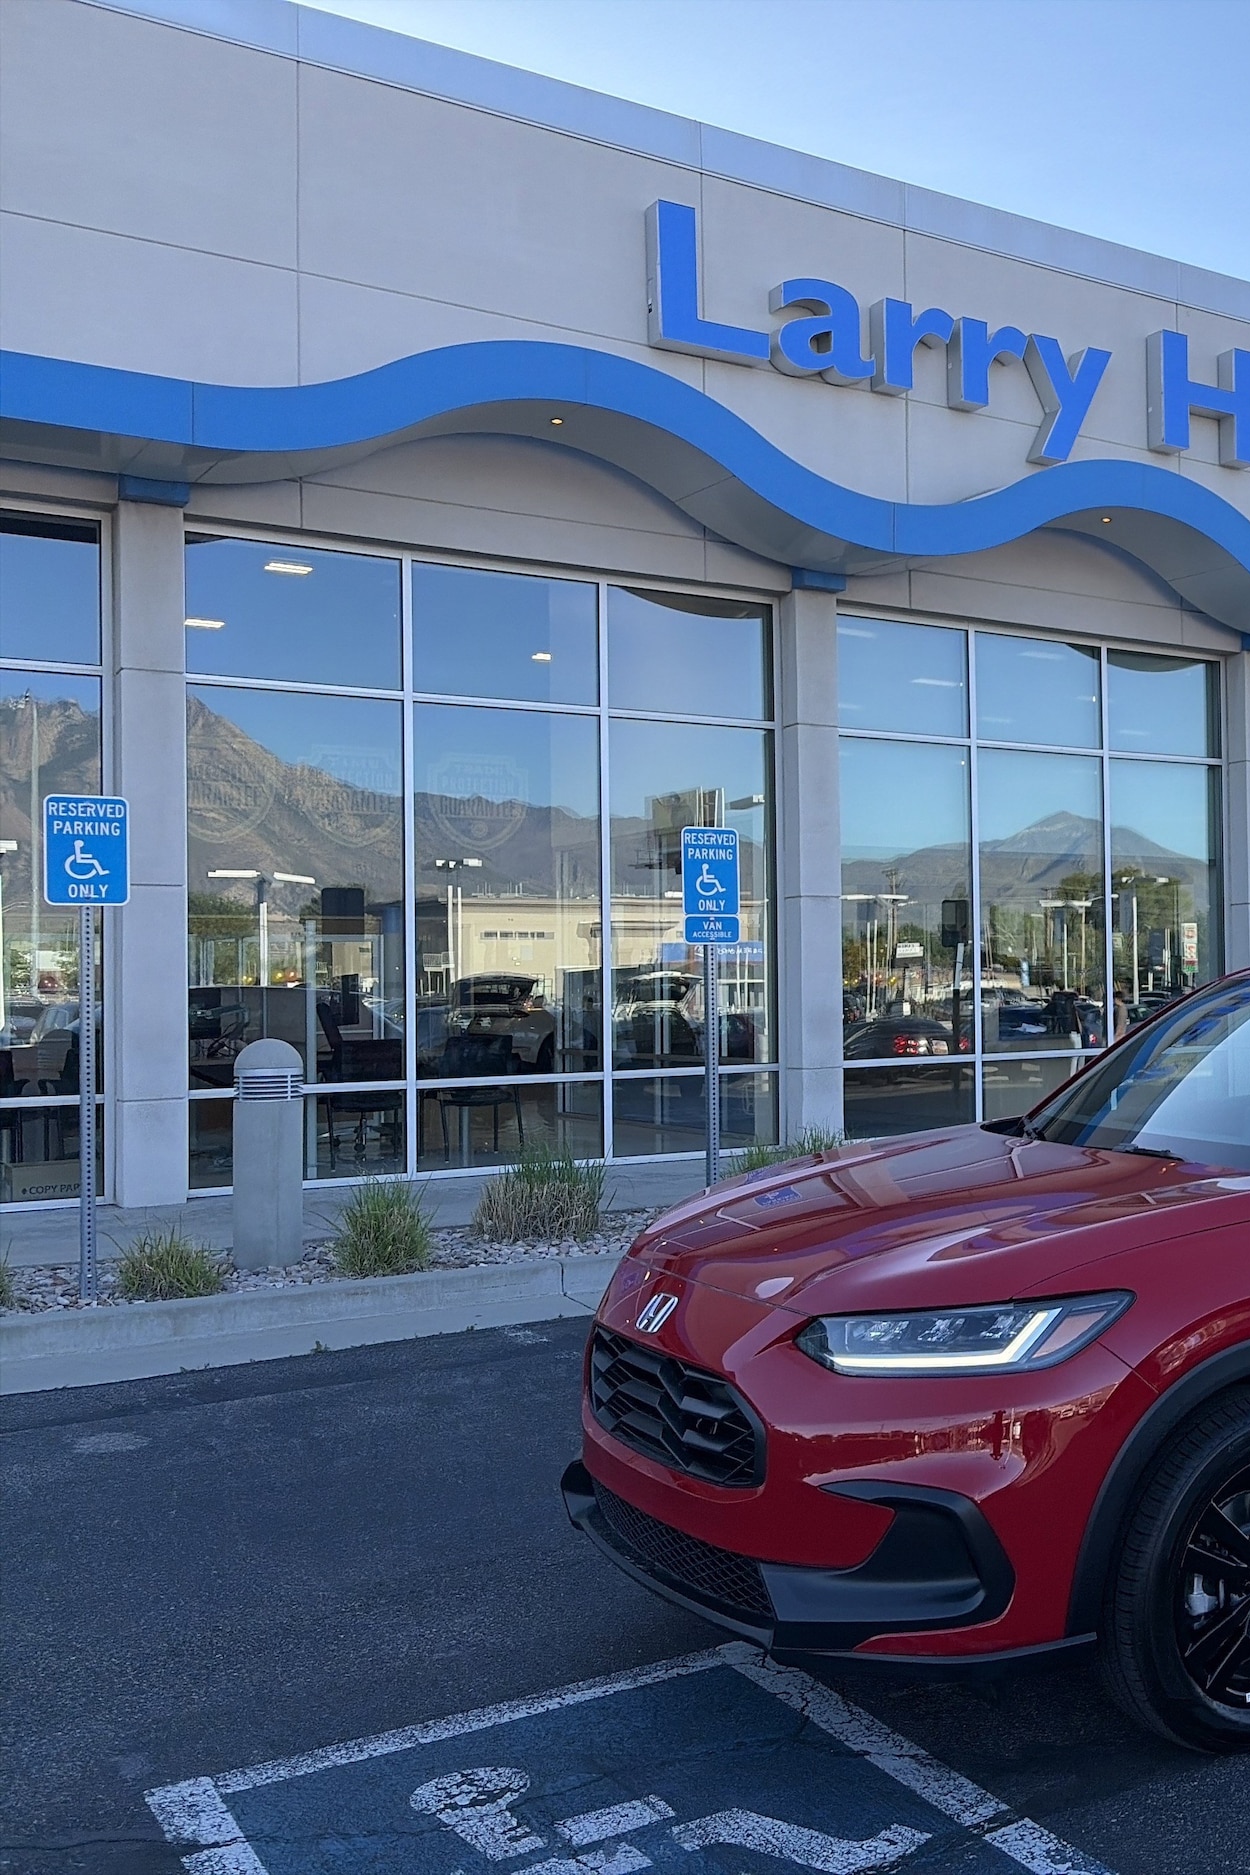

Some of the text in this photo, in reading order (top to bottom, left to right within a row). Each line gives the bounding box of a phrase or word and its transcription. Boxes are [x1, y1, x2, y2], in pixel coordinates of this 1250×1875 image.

[646, 198, 1113, 464] Larry
[48, 801, 125, 818] RESERVED
[53, 820, 121, 836] PARKING
[684, 832, 736, 846] RESERVED
[687, 847, 733, 860] PARKING
[68, 883, 109, 898] ONLY
[698, 899, 726, 911] ONLY
[702, 921, 722, 931] VAN
[692, 931, 732, 939] ACCESSIBLE
[29, 1183, 80, 1195] COPY PAP
